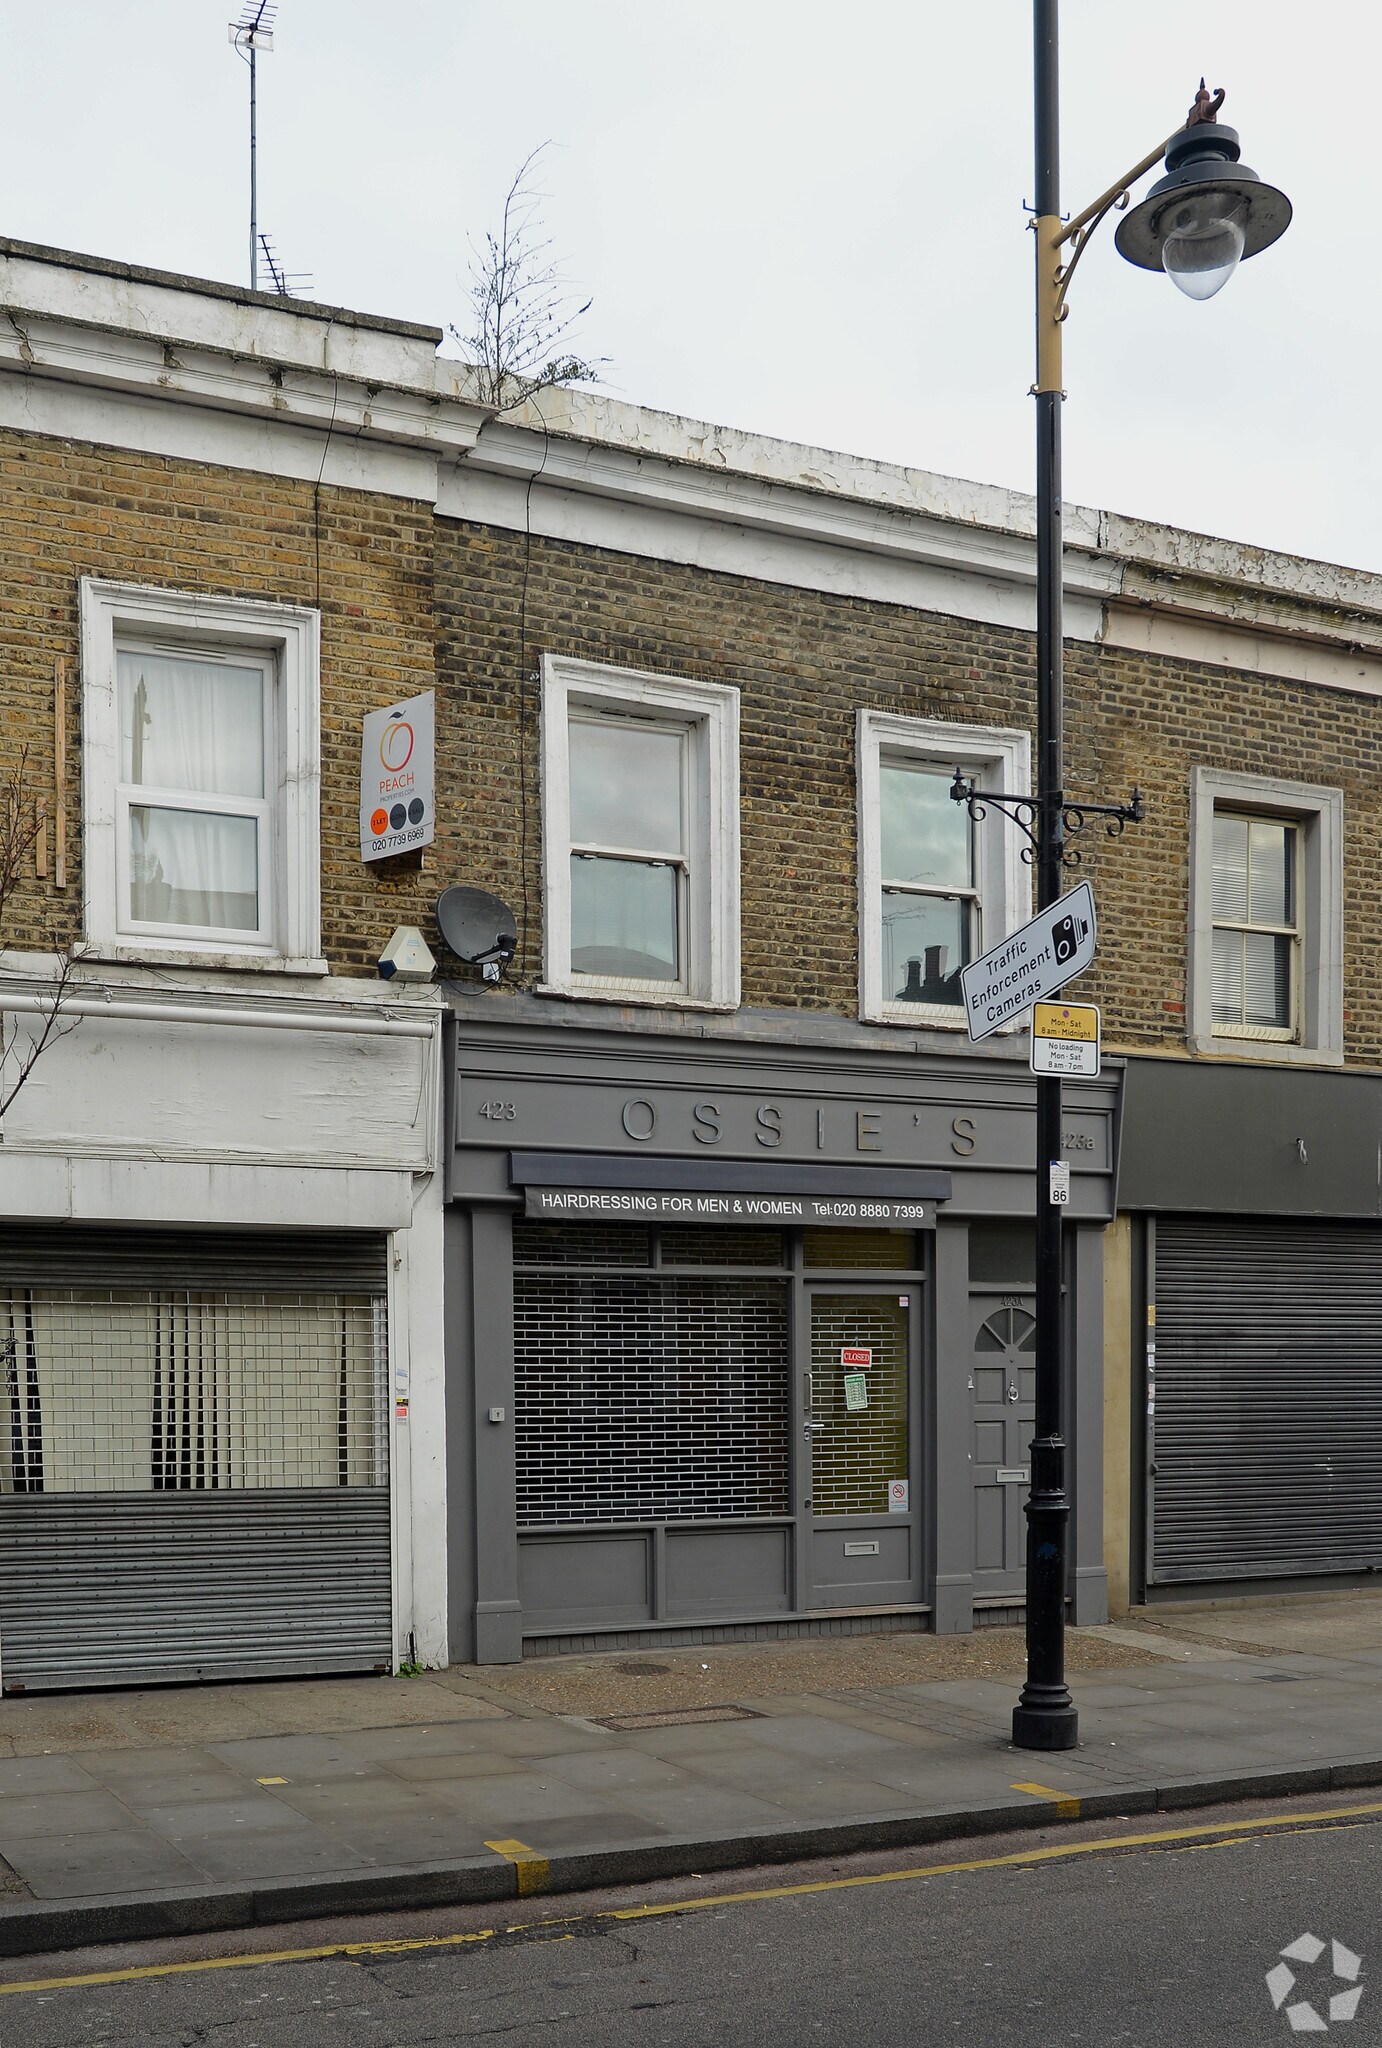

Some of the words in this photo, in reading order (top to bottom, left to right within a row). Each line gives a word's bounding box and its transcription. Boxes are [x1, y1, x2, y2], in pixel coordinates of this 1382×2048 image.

[380, 771, 415, 794] PEACH
[376, 817, 386, 825] LET
[372, 838, 387, 852] 020
[388, 833, 406, 848] 7739
[407, 827, 424, 842] 6969
[985, 940, 1028, 977] Traffic
[971, 946, 1051, 1011] Enforcement
[986, 978, 1042, 1023] Cameras
[1051, 1018, 1065, 1026] Mon
[1070, 1020, 1082, 1028] Sat
[1061, 1028, 1091, 1038] Midnight
[1048, 1042, 1058, 1050] No
[1059, 1042, 1084, 1053] loading
[1050, 1051, 1065, 1059] Mon
[1069, 1053, 1082, 1061] Sat
[479, 1100, 517, 1121] 423
[622, 1098, 978, 1156] OSSIE'S
[541, 1193, 658, 1211] HAIRDRESSING
[661, 1197, 693, 1212] FOR
[697, 1198, 729, 1213] MEN
[732, 1199, 743, 1213] &
[746, 1200, 803, 1215] WOMEN
[860, 1204, 890, 1218] 8880
[893, 1205, 924, 1219] 7399
[1053, 1190, 1067, 1202] 86
[843, 1352, 870, 1362] CLOSED
